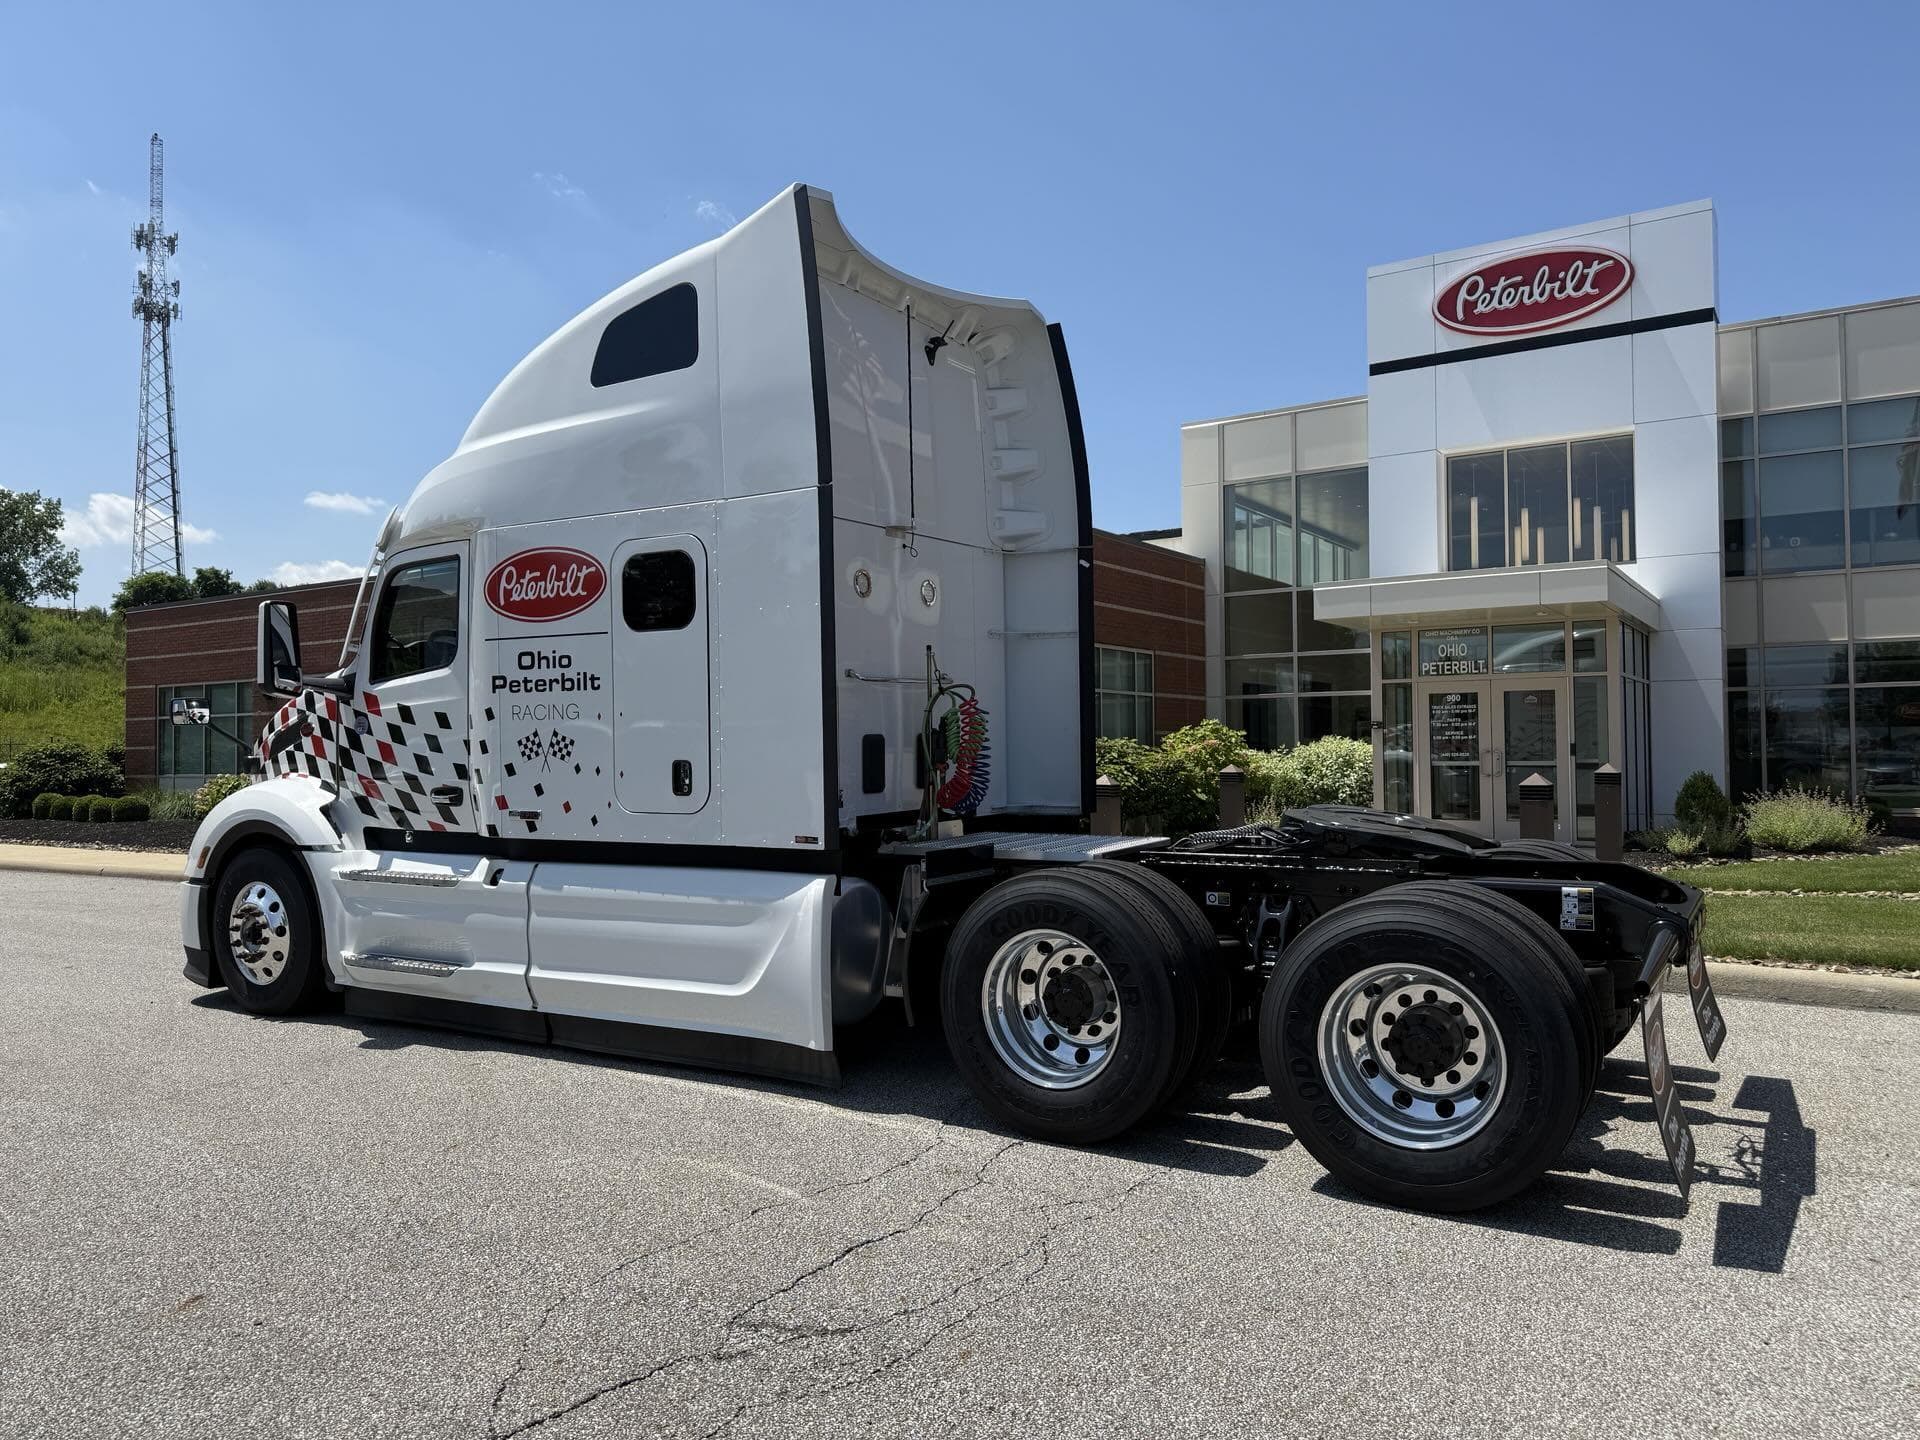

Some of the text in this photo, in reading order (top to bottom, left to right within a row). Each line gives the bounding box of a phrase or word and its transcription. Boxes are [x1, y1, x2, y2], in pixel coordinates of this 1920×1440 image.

[1456, 259, 1614, 322] Peterbilt
[499, 563, 597, 606] Peterbilt
[1438, 643, 1468, 657] OHIO
[517, 650, 572, 671] Ohio
[1422, 660, 1485, 675] PETERBILT
[491, 672, 601, 694] Peterbilt
[1446, 694, 1461, 702] 900
[511, 703, 580, 721] RACING
